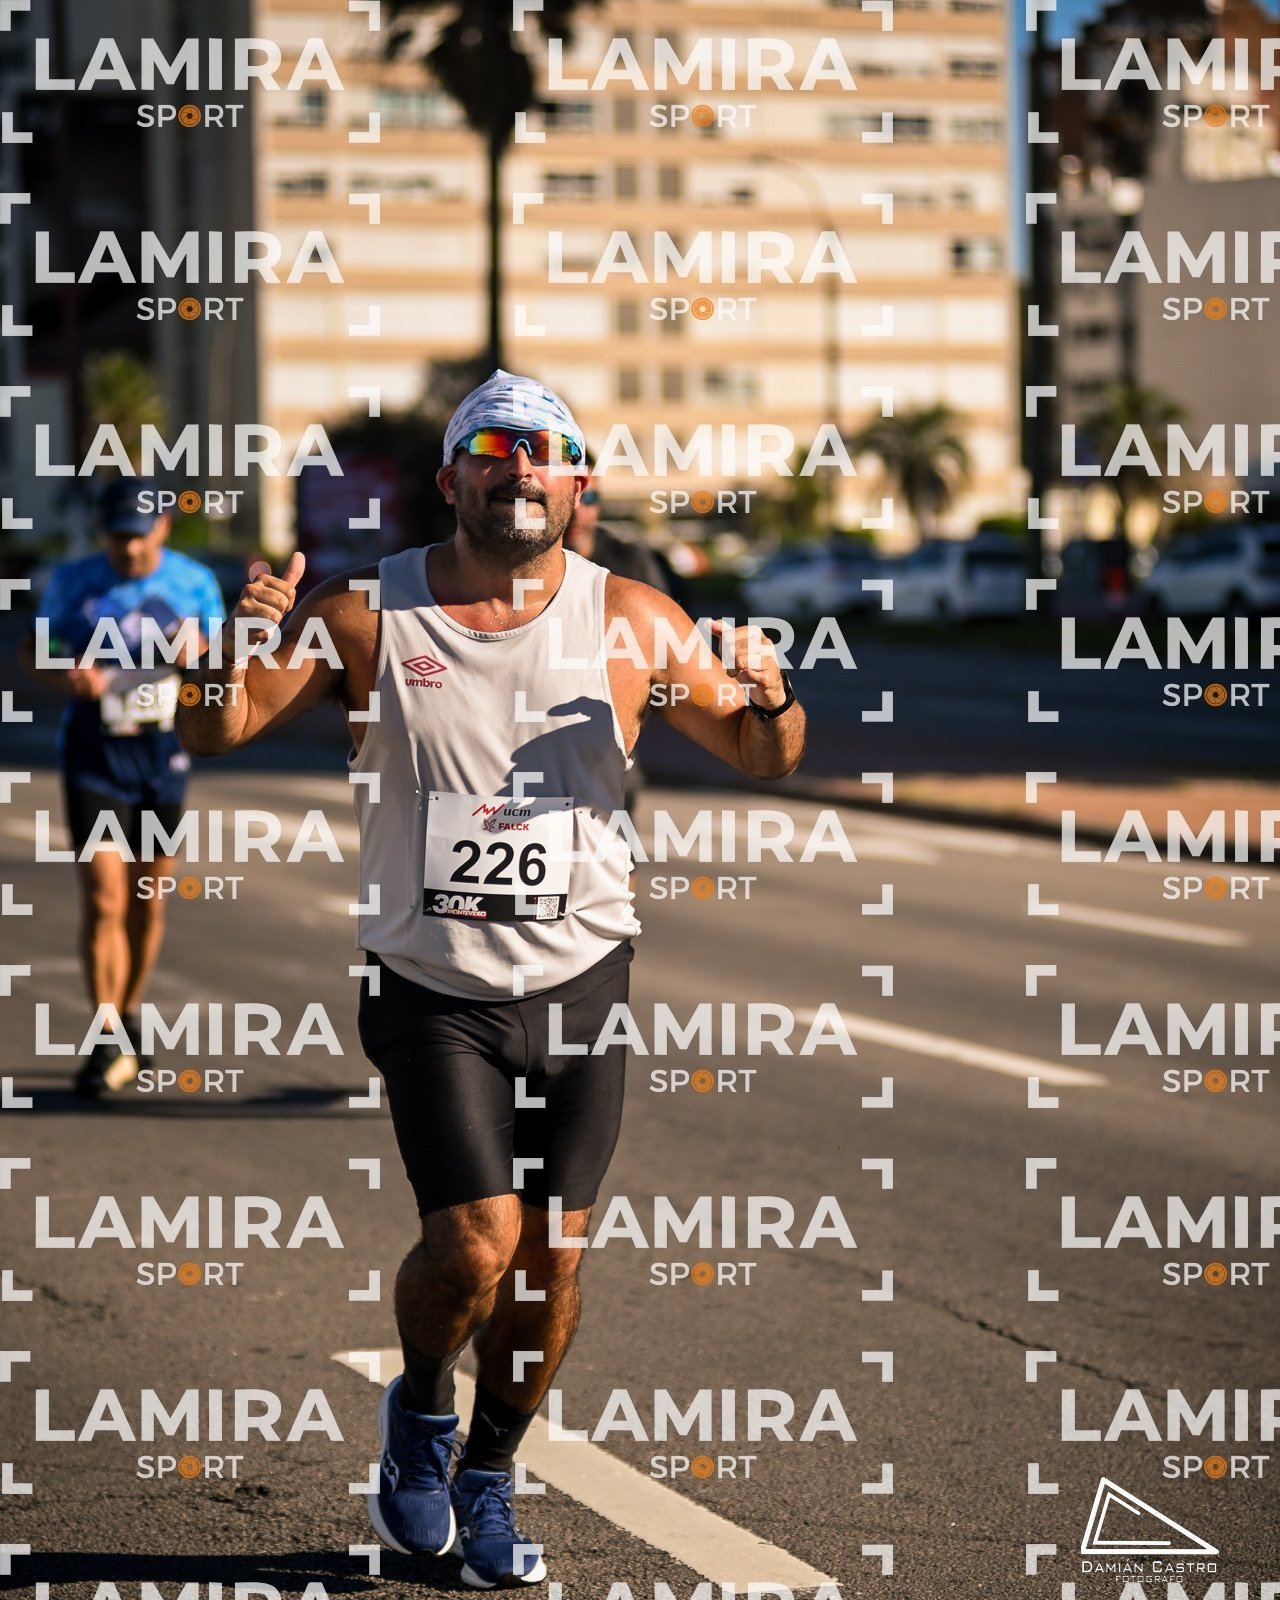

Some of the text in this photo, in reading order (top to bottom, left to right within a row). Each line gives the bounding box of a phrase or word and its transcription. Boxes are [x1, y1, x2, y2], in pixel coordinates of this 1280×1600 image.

[405, 678, 442, 689] umbro
[503, 807, 531, 817] ucm
[498, 823, 529, 831] FALCK
[450, 840, 547, 886] 226
[432, 894, 483, 914] 30K
